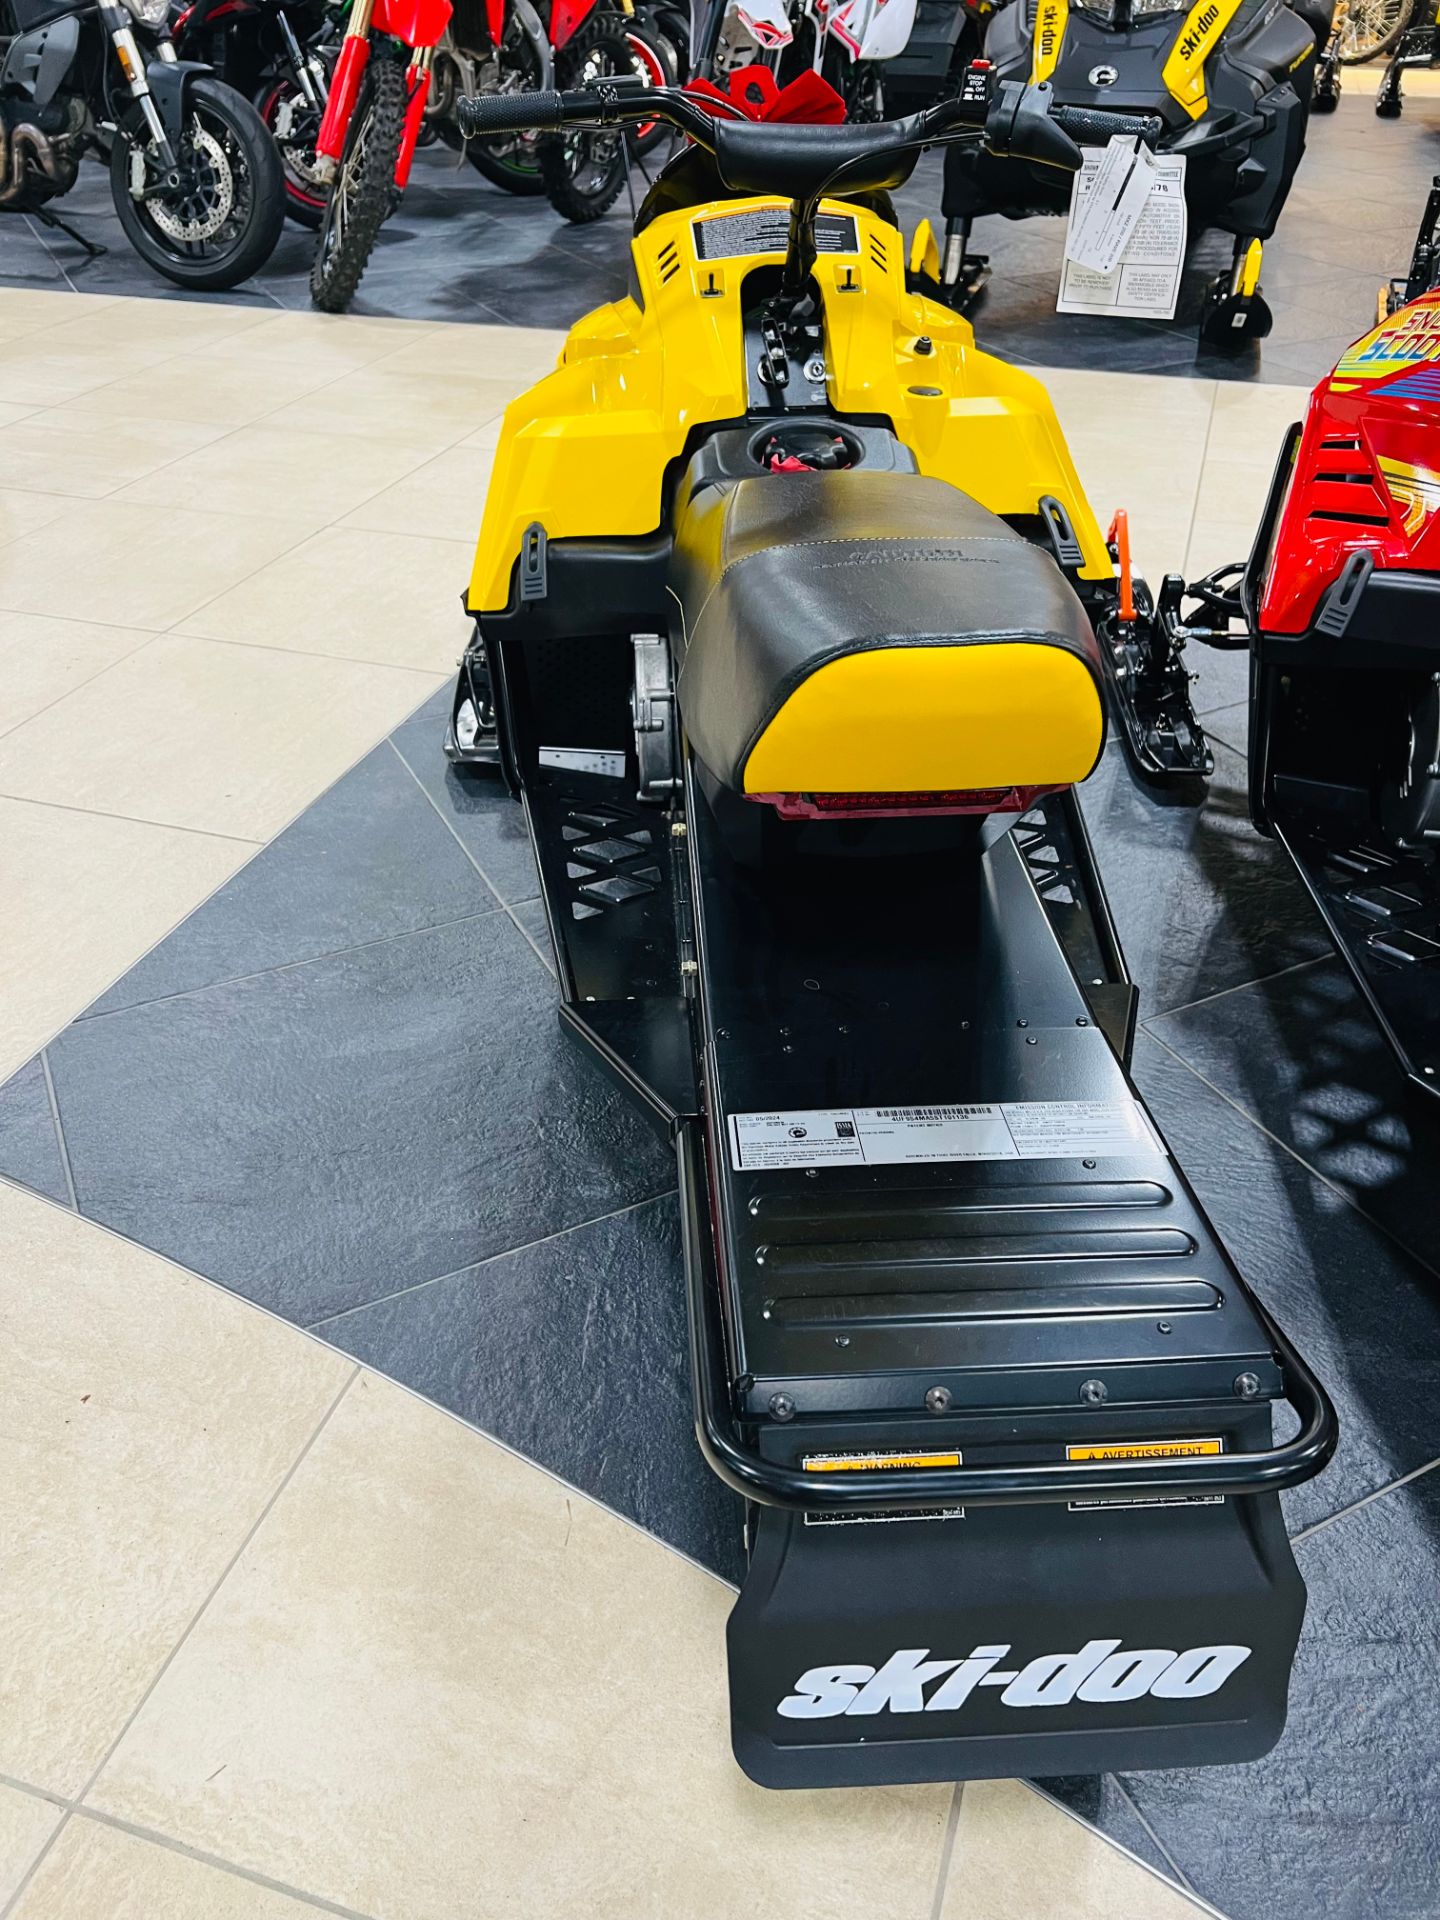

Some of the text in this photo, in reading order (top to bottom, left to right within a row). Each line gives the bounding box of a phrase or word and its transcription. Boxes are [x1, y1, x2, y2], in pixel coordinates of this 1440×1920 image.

[1042, 5, 1058, 55] ski-doo
[1179, 4, 1220, 60] ski-doo
[1357, 331, 1440, 361] SCOO
[1102, 1446, 1203, 1460] AVERTISSEMENT
[776, 1638, 1252, 1718] ski-doo
